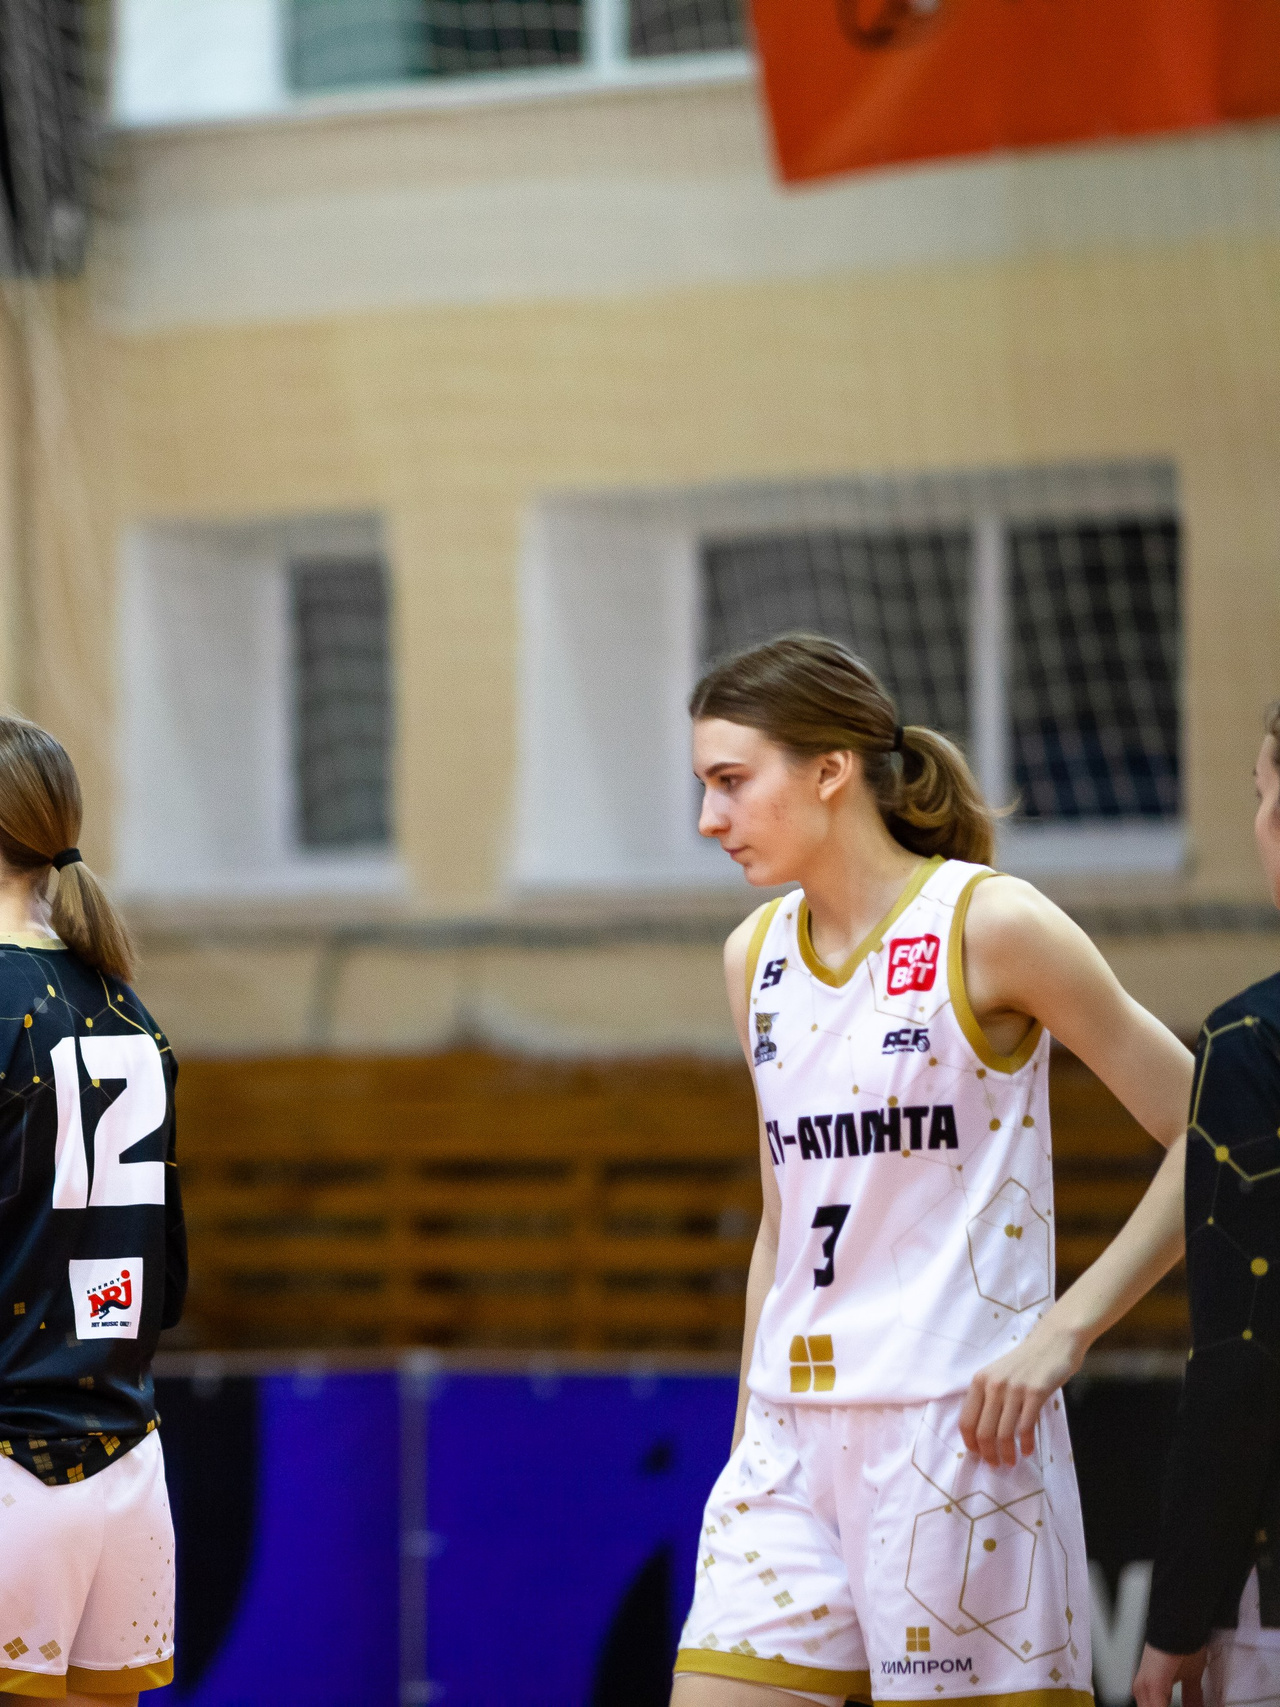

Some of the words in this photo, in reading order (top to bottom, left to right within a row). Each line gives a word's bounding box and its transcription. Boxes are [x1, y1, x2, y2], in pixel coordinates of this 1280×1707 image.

[892, 940, 936, 966] FON
[890, 961, 934, 989] BET
[50, 1034, 167, 1209] 12
[811, 1204, 851, 1290] 3
[881, 1657, 972, 1674] ХИМПРОМ
